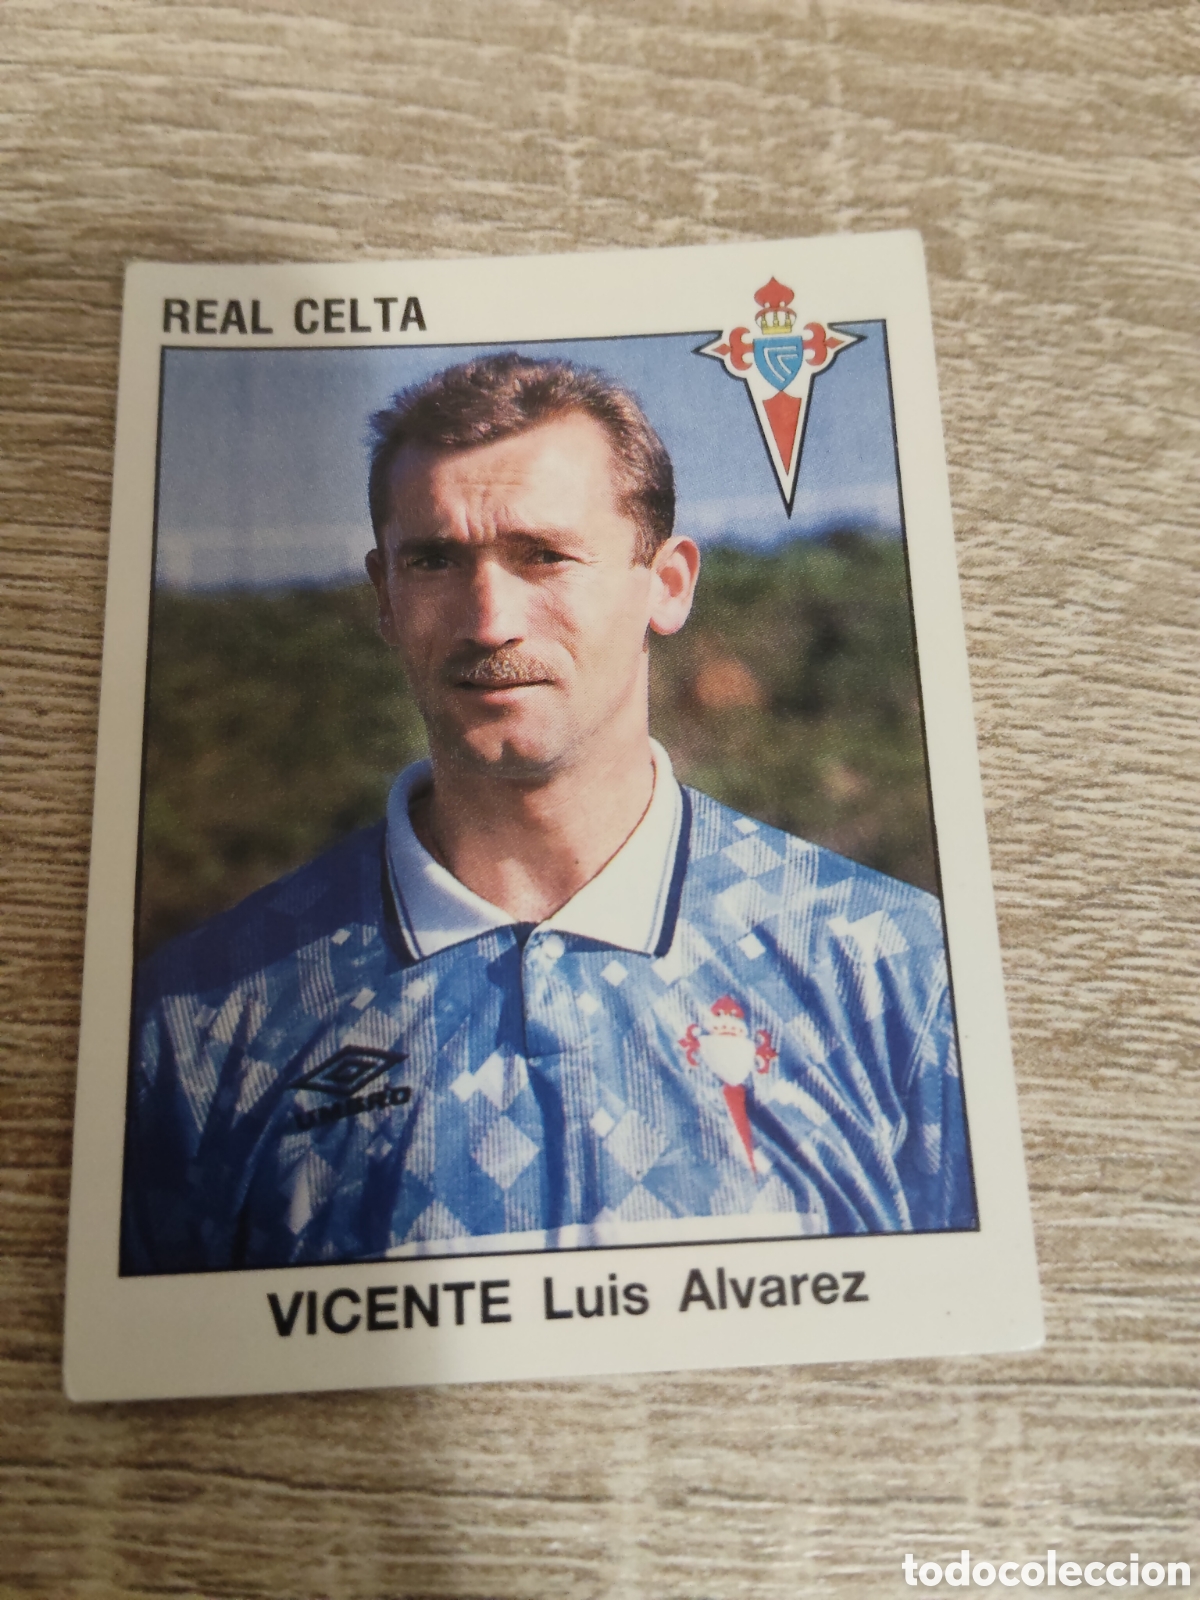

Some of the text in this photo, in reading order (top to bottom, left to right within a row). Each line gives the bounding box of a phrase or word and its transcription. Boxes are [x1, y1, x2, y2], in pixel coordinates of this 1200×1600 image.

[163, 296, 428, 334] REAL CELTA
[267, 1267, 869, 1336] VICENTE Luis Alvarez
